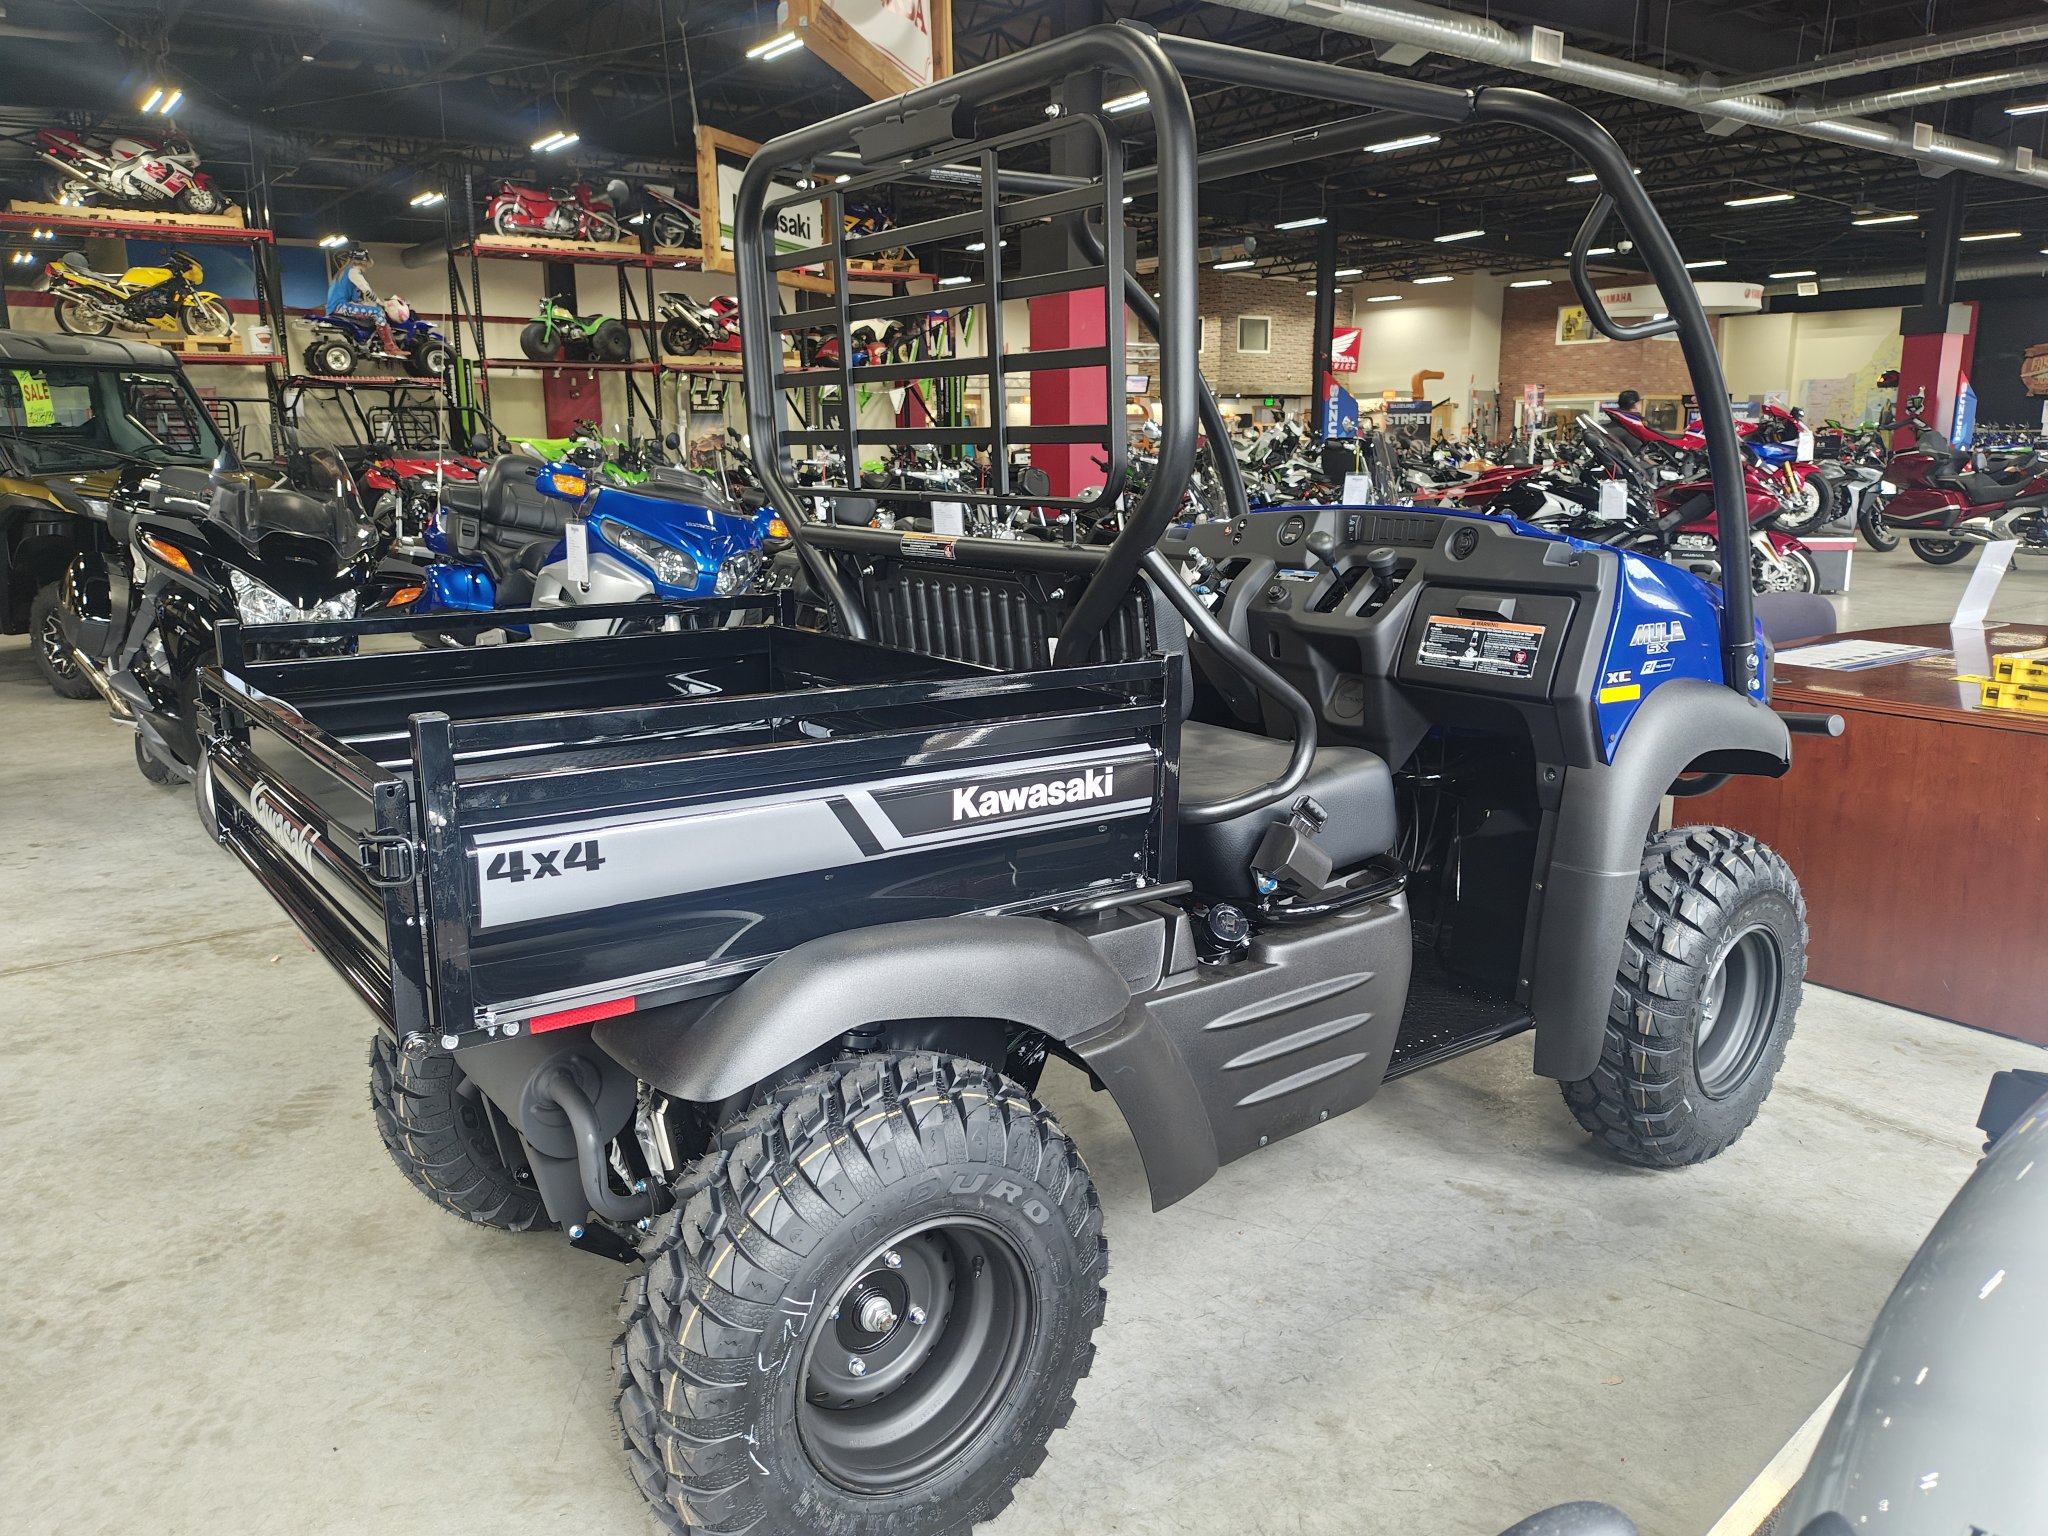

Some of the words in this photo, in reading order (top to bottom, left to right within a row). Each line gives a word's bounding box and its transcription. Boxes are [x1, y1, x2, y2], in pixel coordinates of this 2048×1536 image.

[23, 382, 50, 402] SALE
[1386, 413, 1431, 425] STREET
[1476, 621, 1499, 633] WARNING
[1629, 620, 1686, 647] MULE
[1647, 642, 1669, 655] SX
[1606, 670, 1632, 684] XC
[952, 766, 1114, 821] Kawasaki
[486, 840, 606, 883] 4x4
[902, 1172, 1051, 1226] DURO
